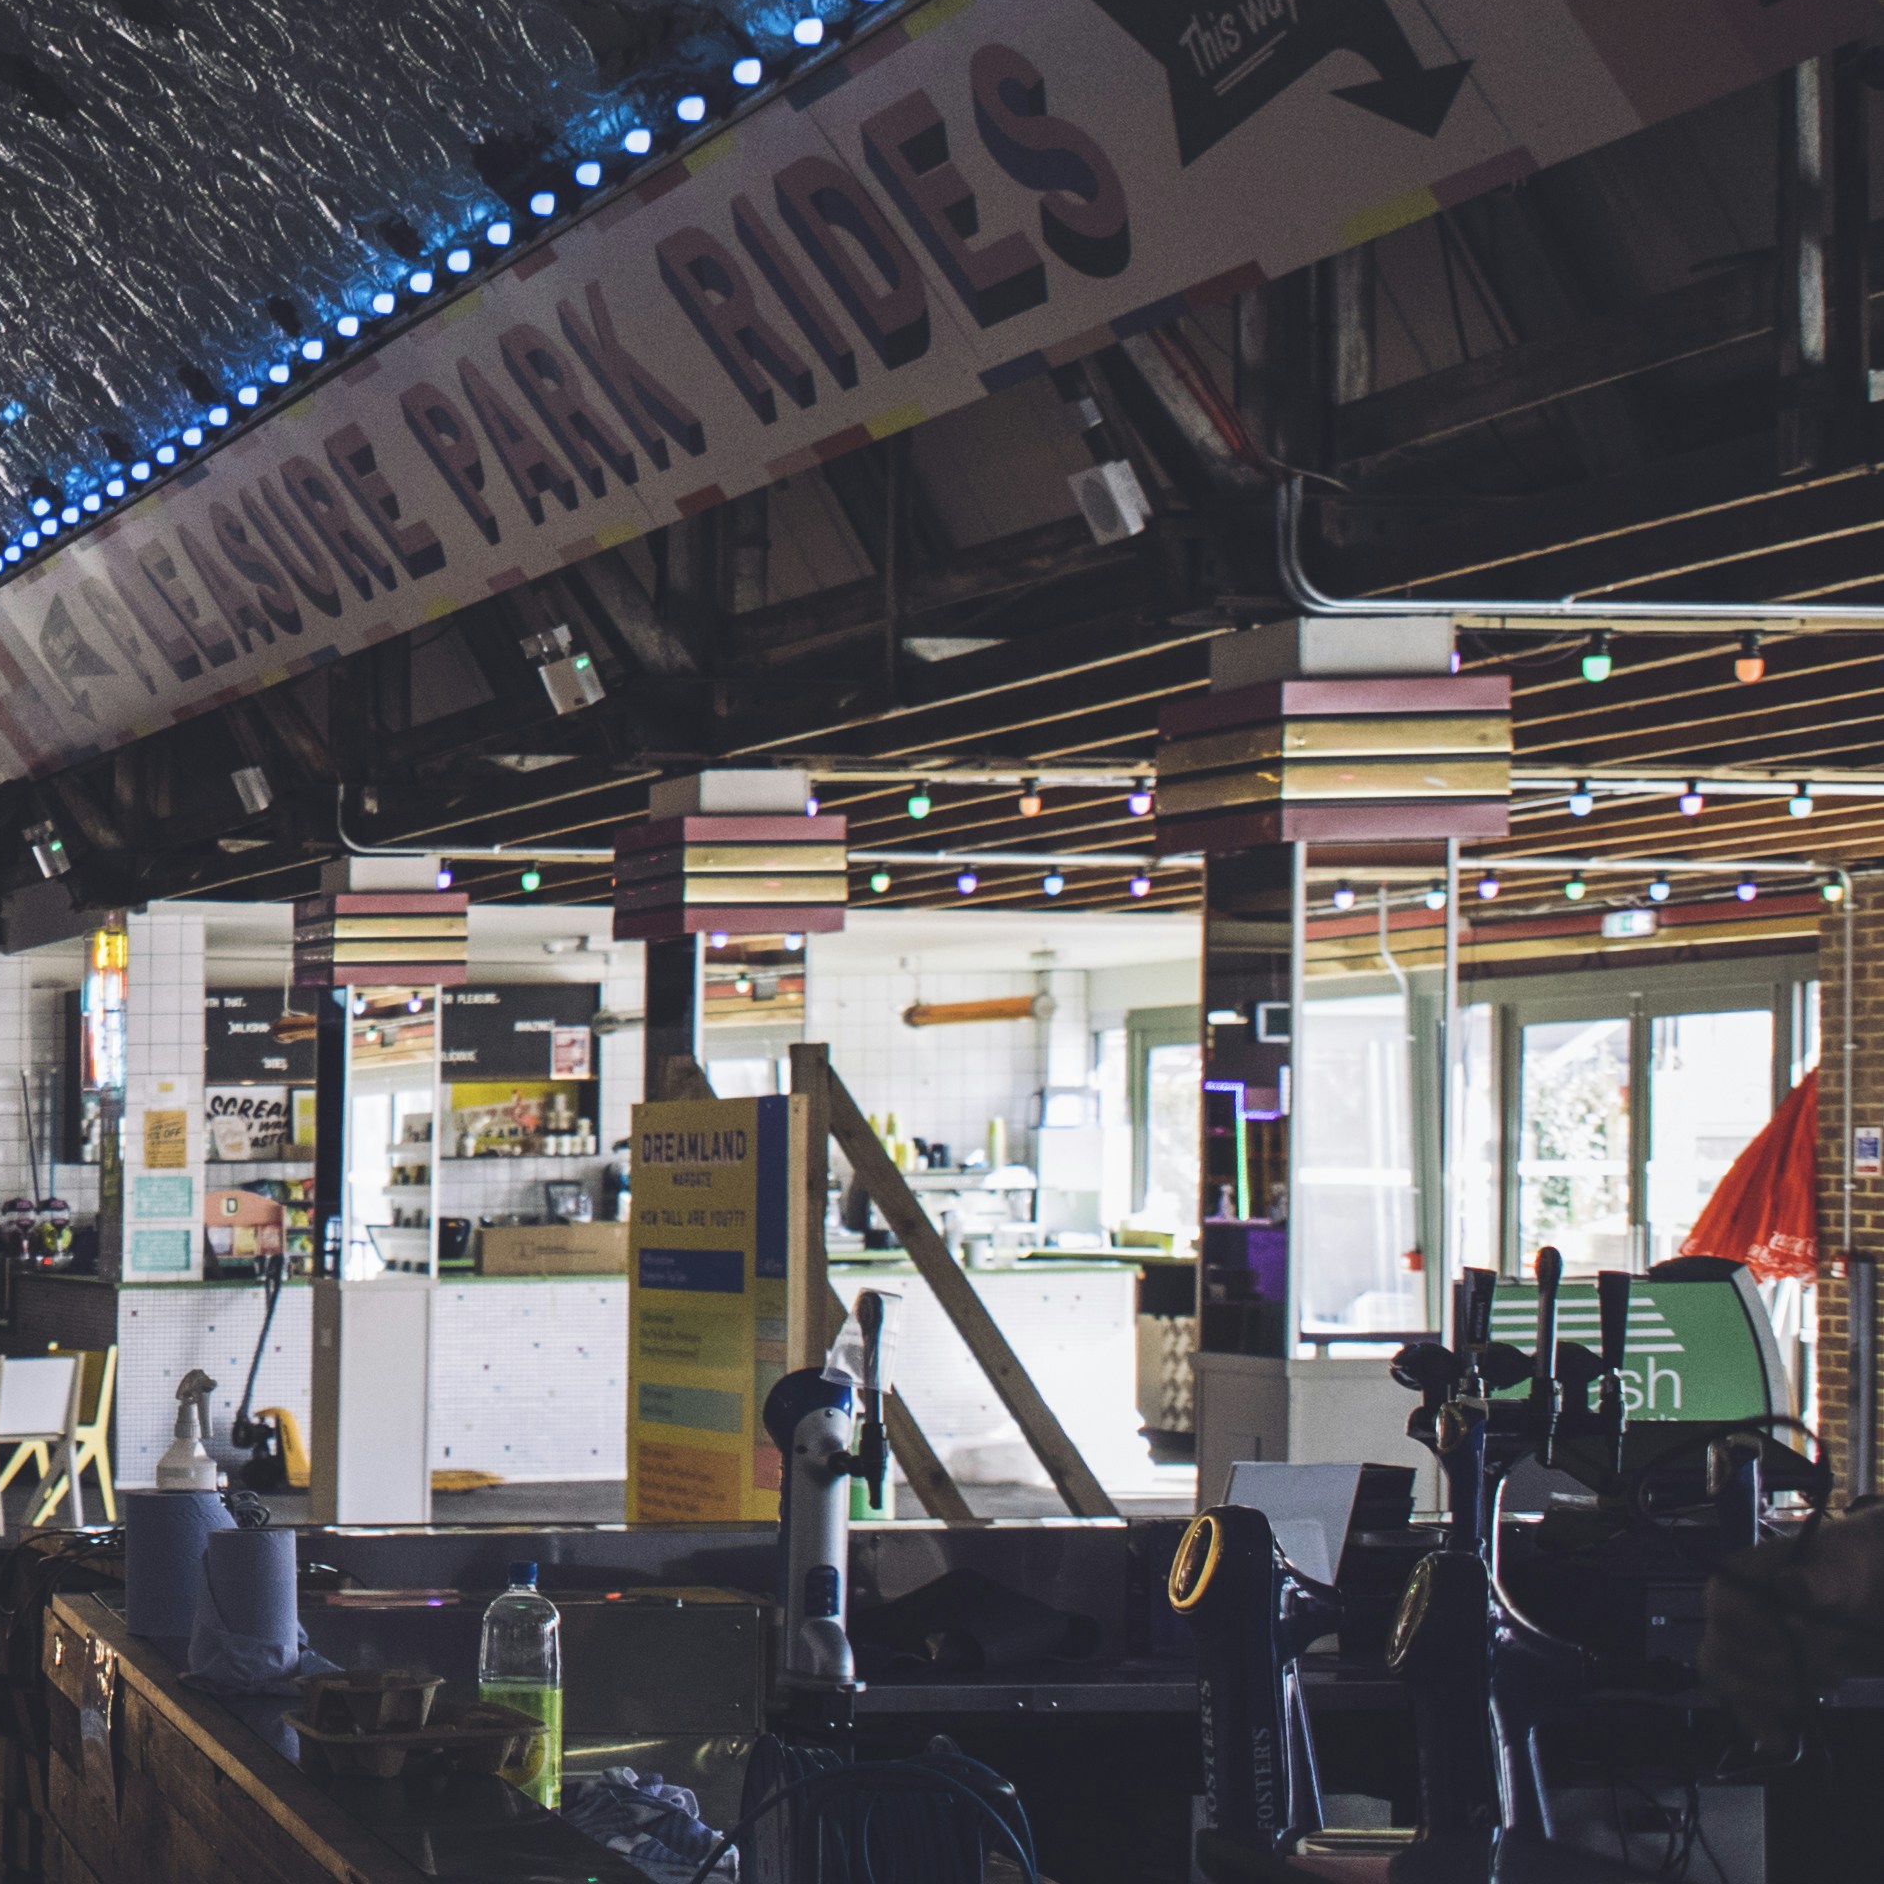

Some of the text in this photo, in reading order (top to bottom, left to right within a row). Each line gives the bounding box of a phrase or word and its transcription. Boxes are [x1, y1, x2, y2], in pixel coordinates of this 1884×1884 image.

[1178, 9, 1243, 77] This
[78, 43, 1123, 696] PLEASURE PARK RIDES
[642, 1129, 747, 1164] DREAMLAND
[1200, 1678, 1219, 1829] FOSTER'S
[1251, 1727, 1275, 1830] FOSTER'S
